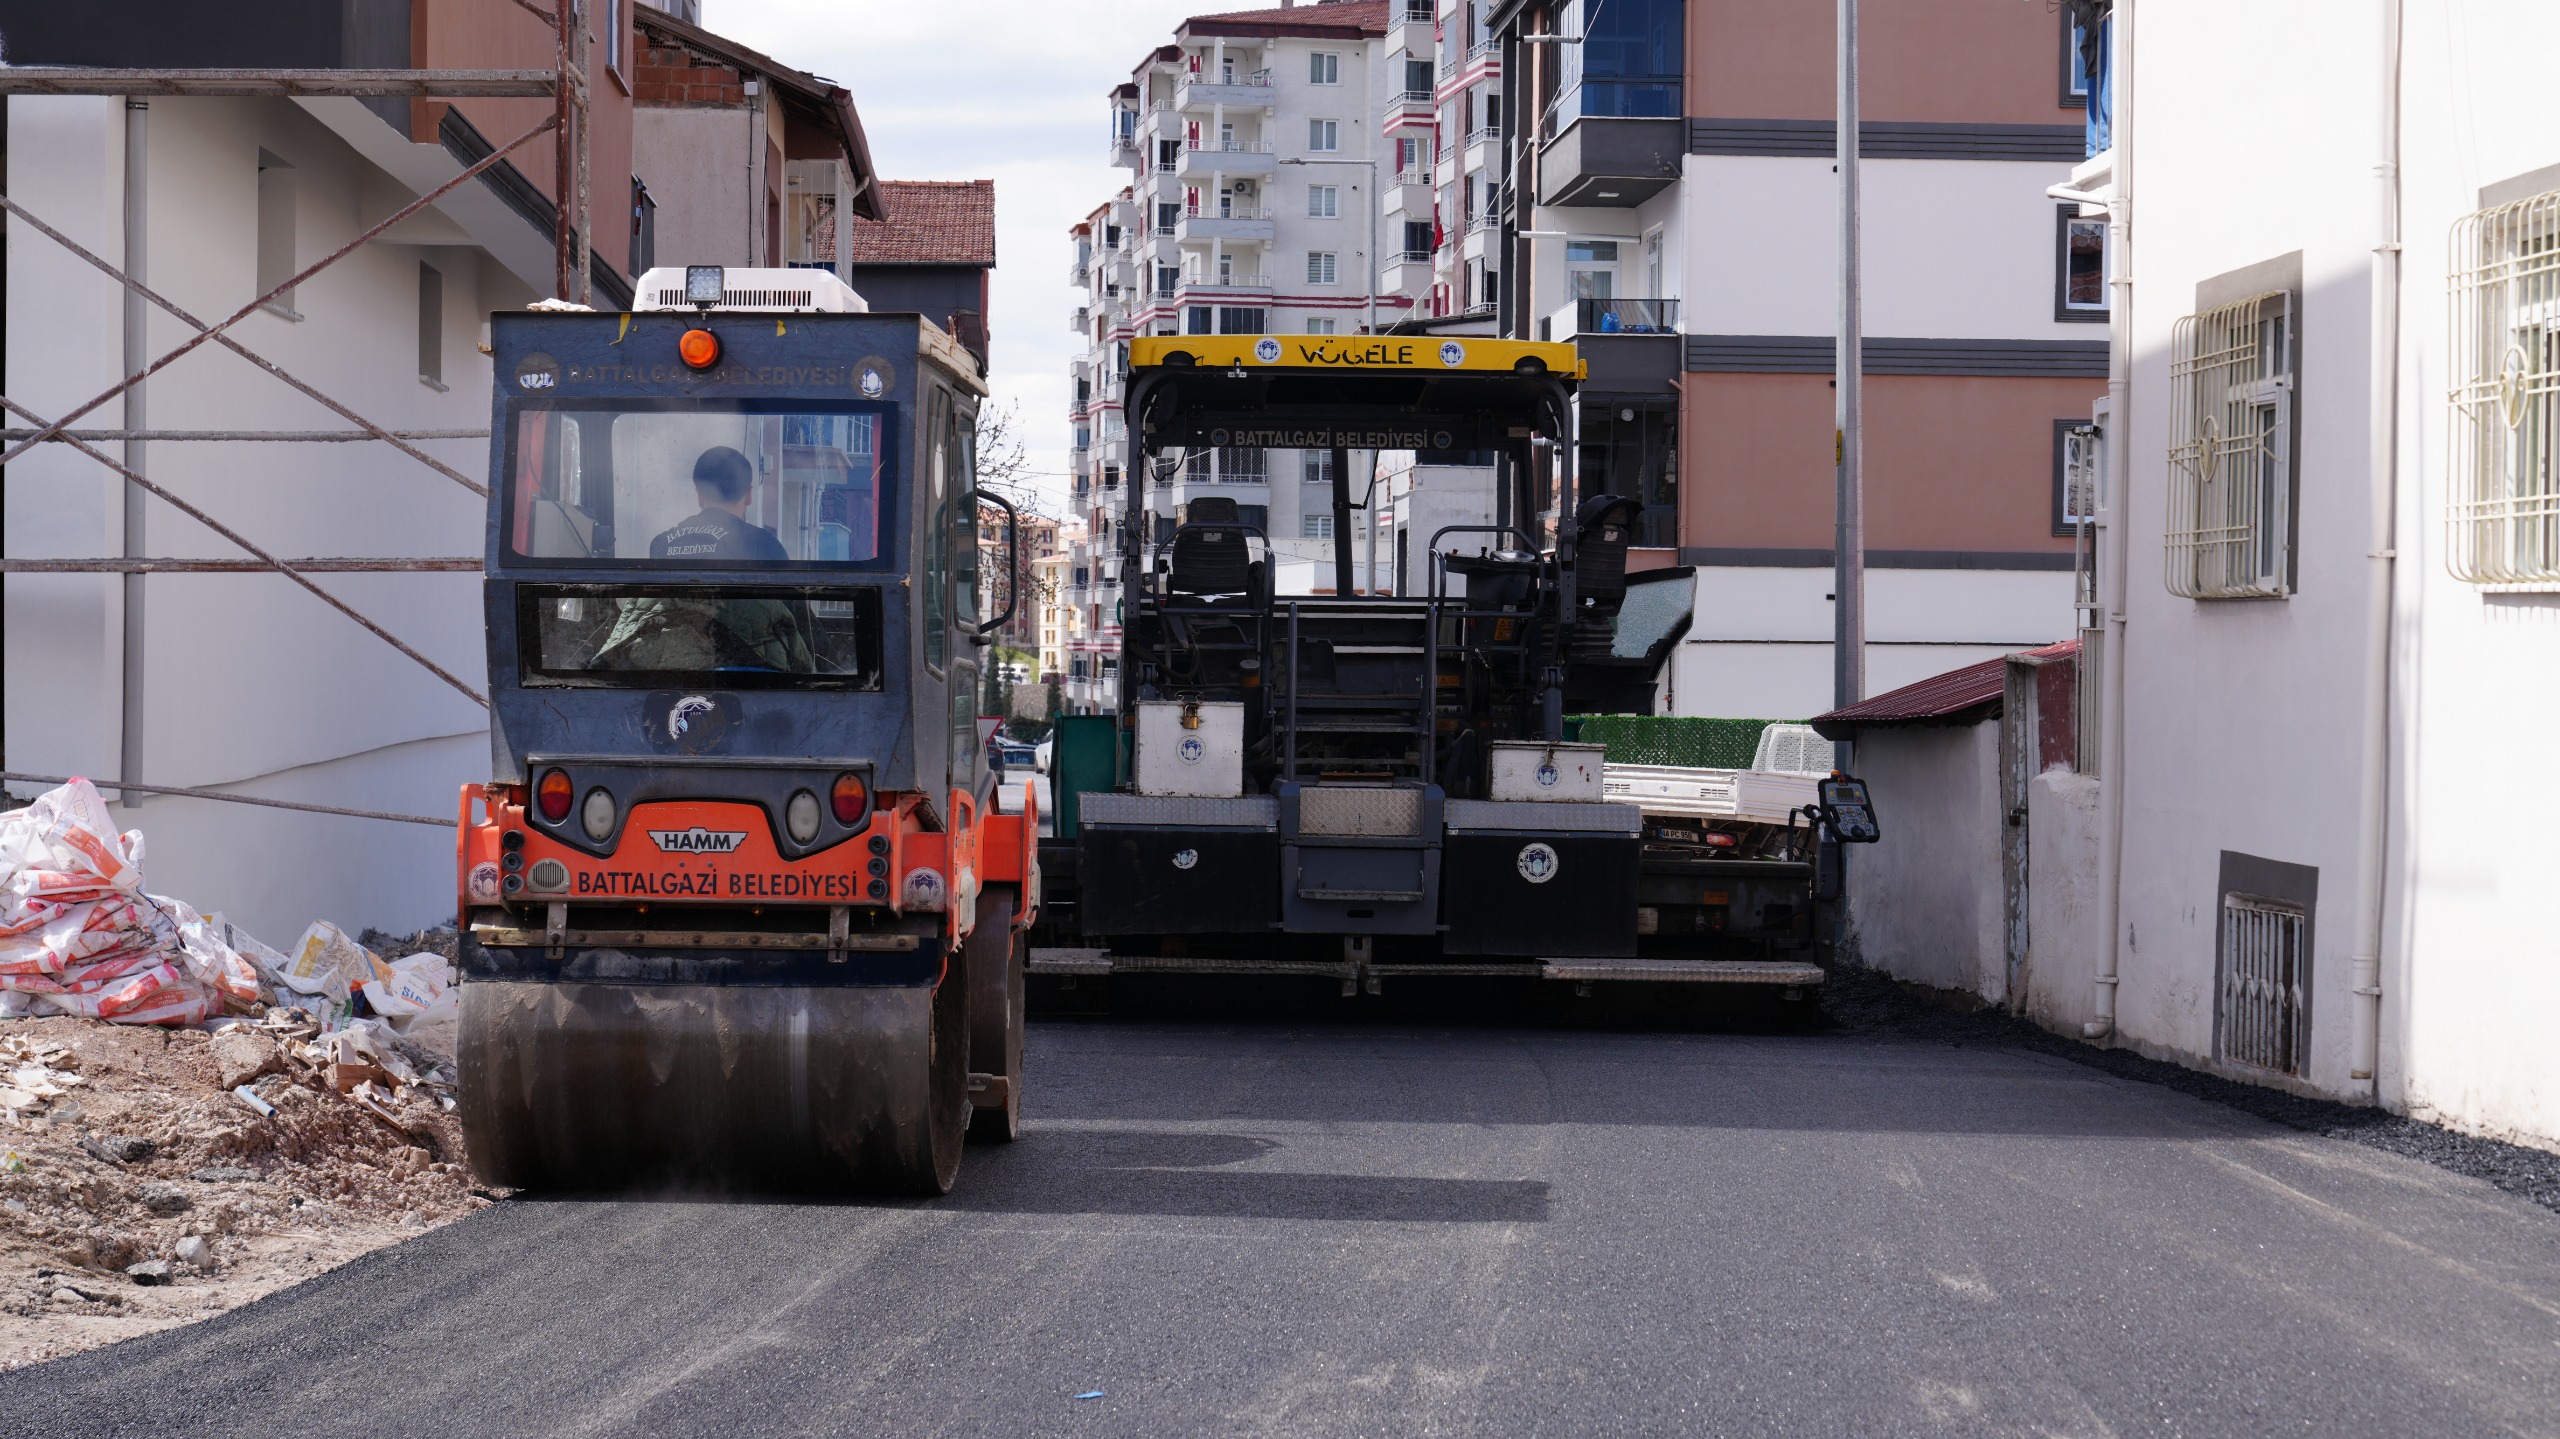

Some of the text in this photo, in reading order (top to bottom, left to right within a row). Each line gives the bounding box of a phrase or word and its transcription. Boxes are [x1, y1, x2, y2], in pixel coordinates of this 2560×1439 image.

[1234, 427, 1428, 449] BATTALGAZİ BELEDİYESİ
[664, 833, 731, 850] HAMM
[578, 868, 857, 897] BATTALGAZİ BELEDİYESİ
